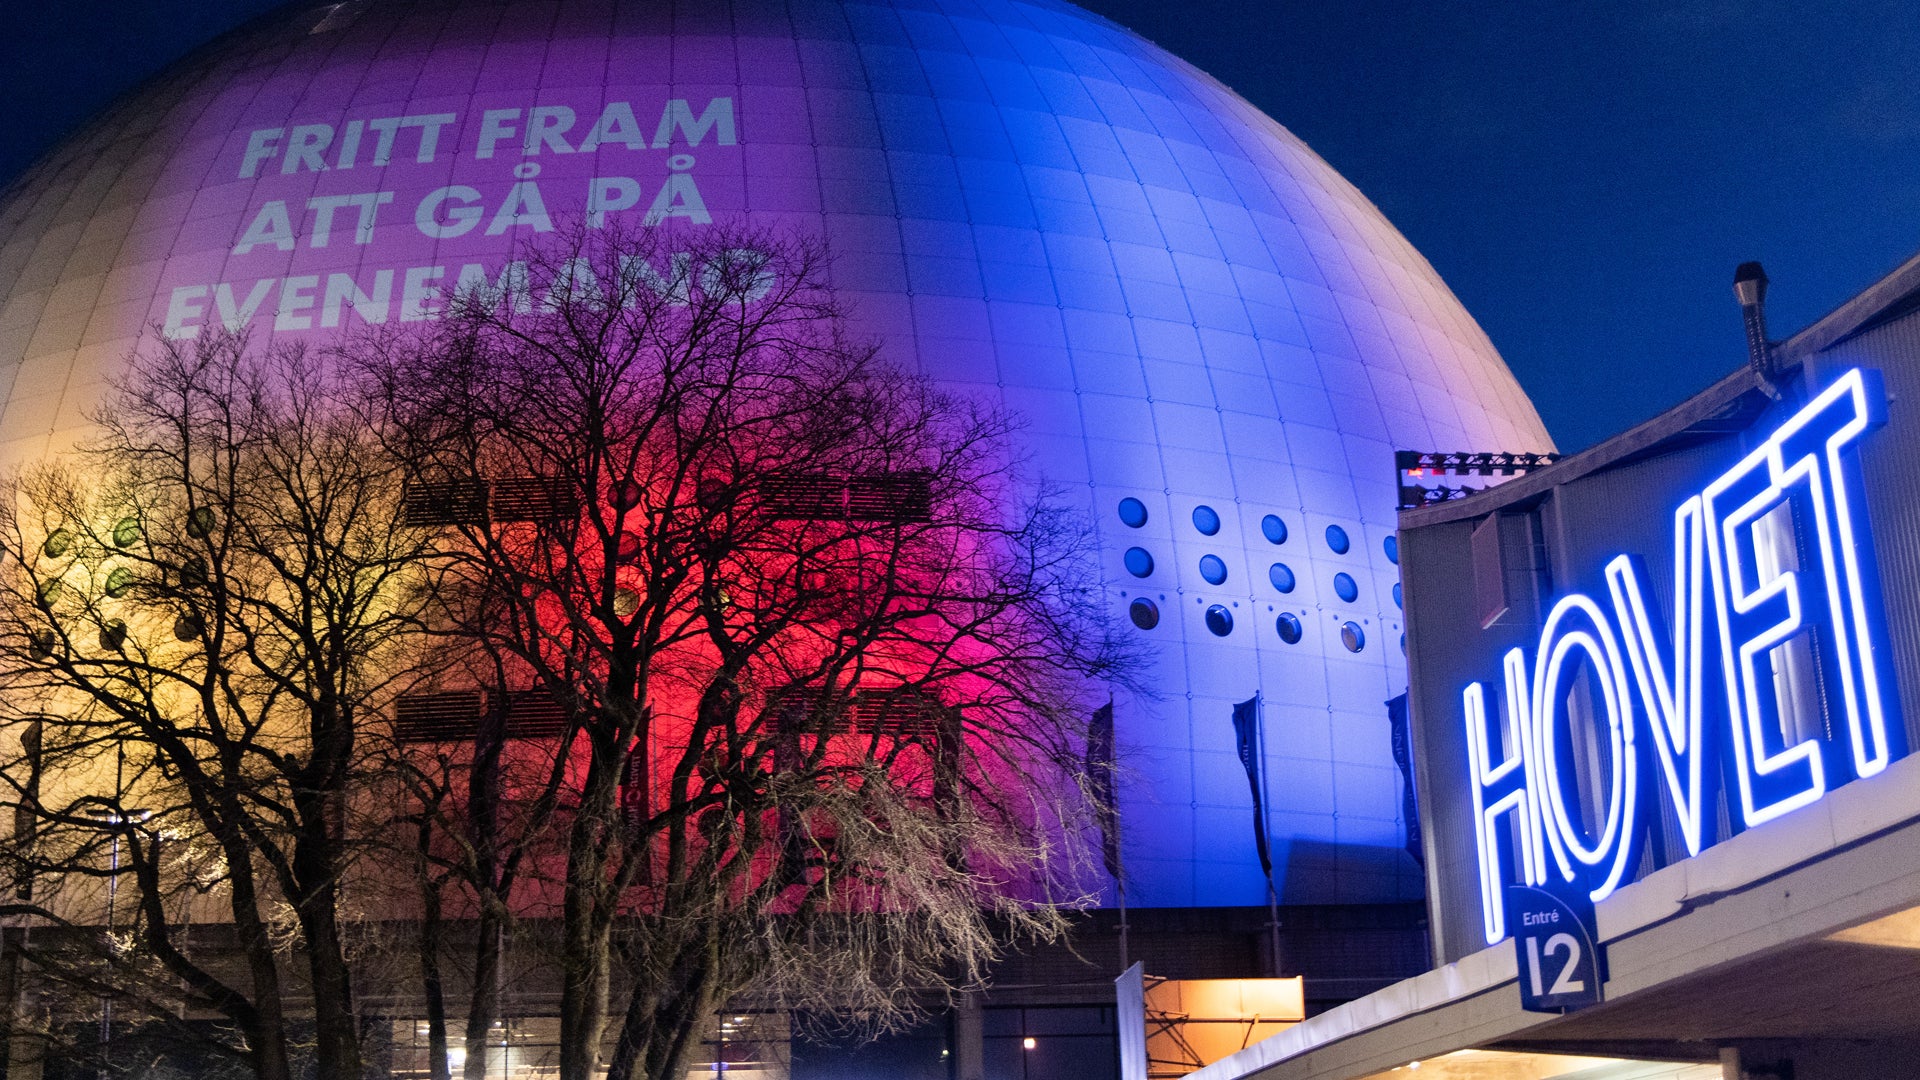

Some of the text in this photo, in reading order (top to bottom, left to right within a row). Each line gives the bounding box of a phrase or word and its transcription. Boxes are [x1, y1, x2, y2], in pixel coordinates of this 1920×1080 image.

[236, 97, 738, 178] FRITT FRAM
[232, 154, 713, 255] ATT GÅ PÅ
[163, 248, 778, 341] EVENEMANG
[1463, 367, 1889, 945] HOVET
[1523, 909, 1560, 926] Entré
[1526, 932, 1585, 997] 12
